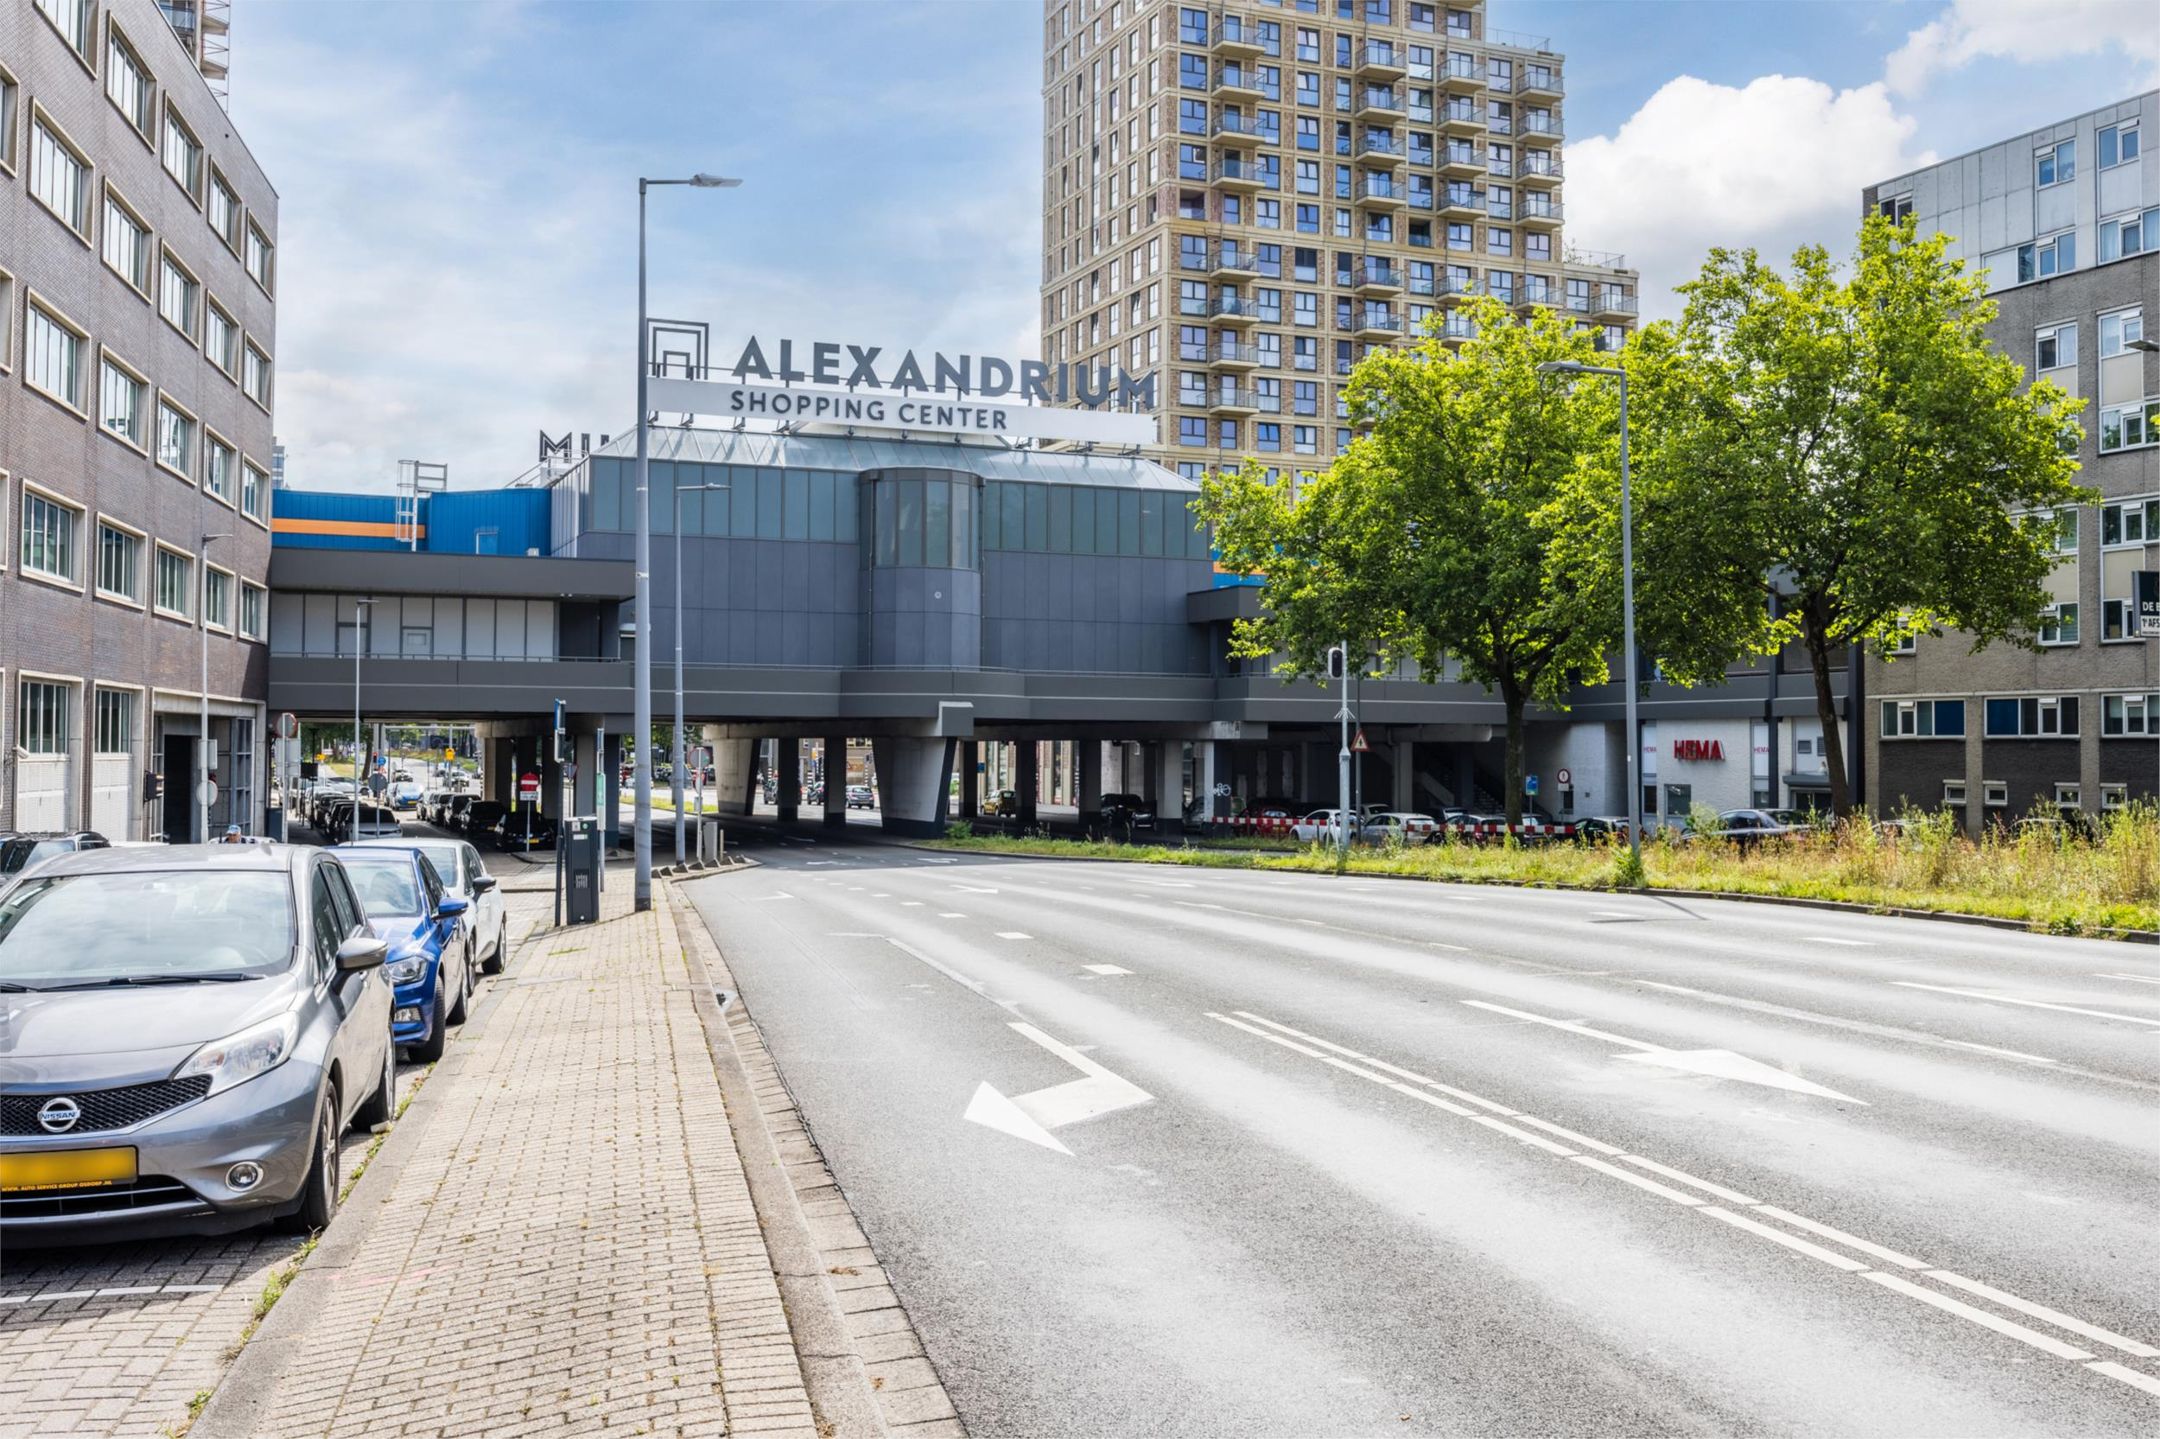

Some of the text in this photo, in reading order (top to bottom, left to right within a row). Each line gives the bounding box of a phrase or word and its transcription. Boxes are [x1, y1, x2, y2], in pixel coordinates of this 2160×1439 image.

[731, 335, 1155, 409] ALEXANDRIUM
[731, 390, 1008, 430] SHOPPING CENTER
[1674, 740, 1724, 760] HEMA
[41, 1111, 75, 1120] NISSAN
